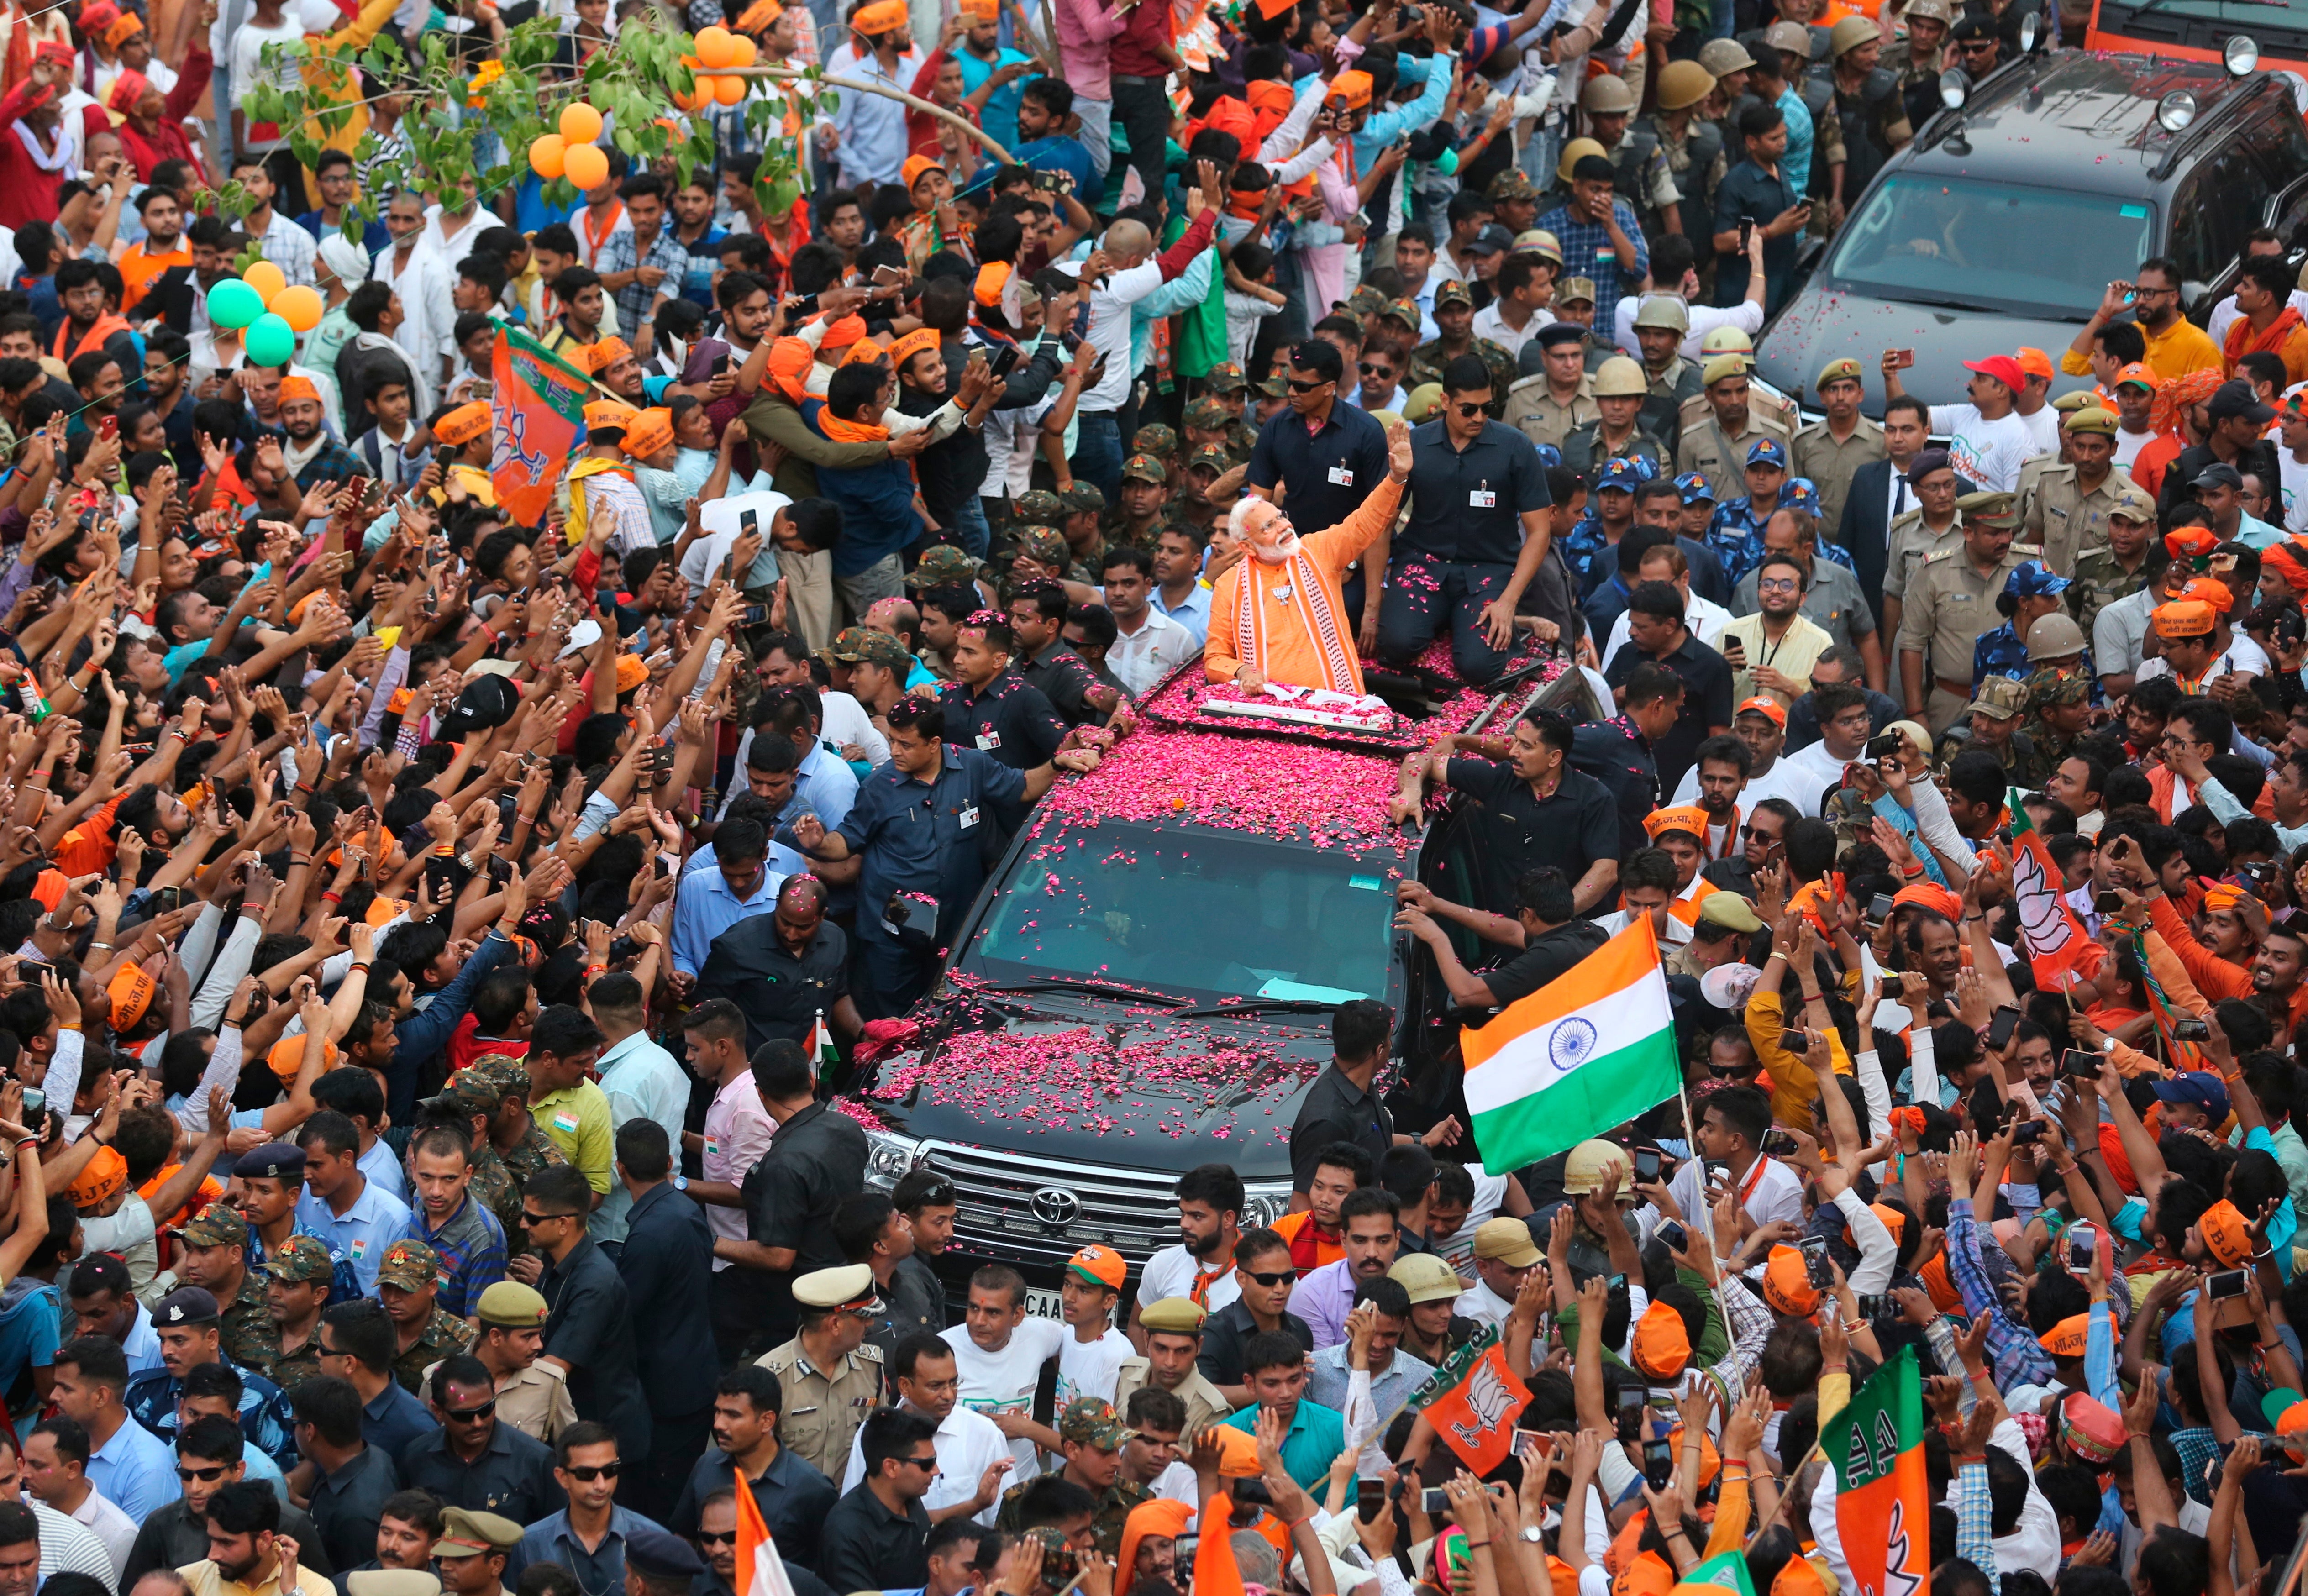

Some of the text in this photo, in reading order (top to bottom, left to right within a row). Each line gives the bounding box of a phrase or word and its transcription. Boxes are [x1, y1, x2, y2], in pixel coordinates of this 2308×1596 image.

[891, 333, 930, 359] भा.ज.पा.
[451, 415, 489, 438] भा.ज.पा.
[598, 415, 631, 424] भा.ज.प
[1651, 815, 1691, 830] भा.ज.पा.
[120, 975, 149, 1021] भा.ज.पा.
[69, 1179, 113, 1202] BJP
[1026, 1295, 1060, 1319] CAA
[2055, 1333, 2087, 1353] भा.ज.
